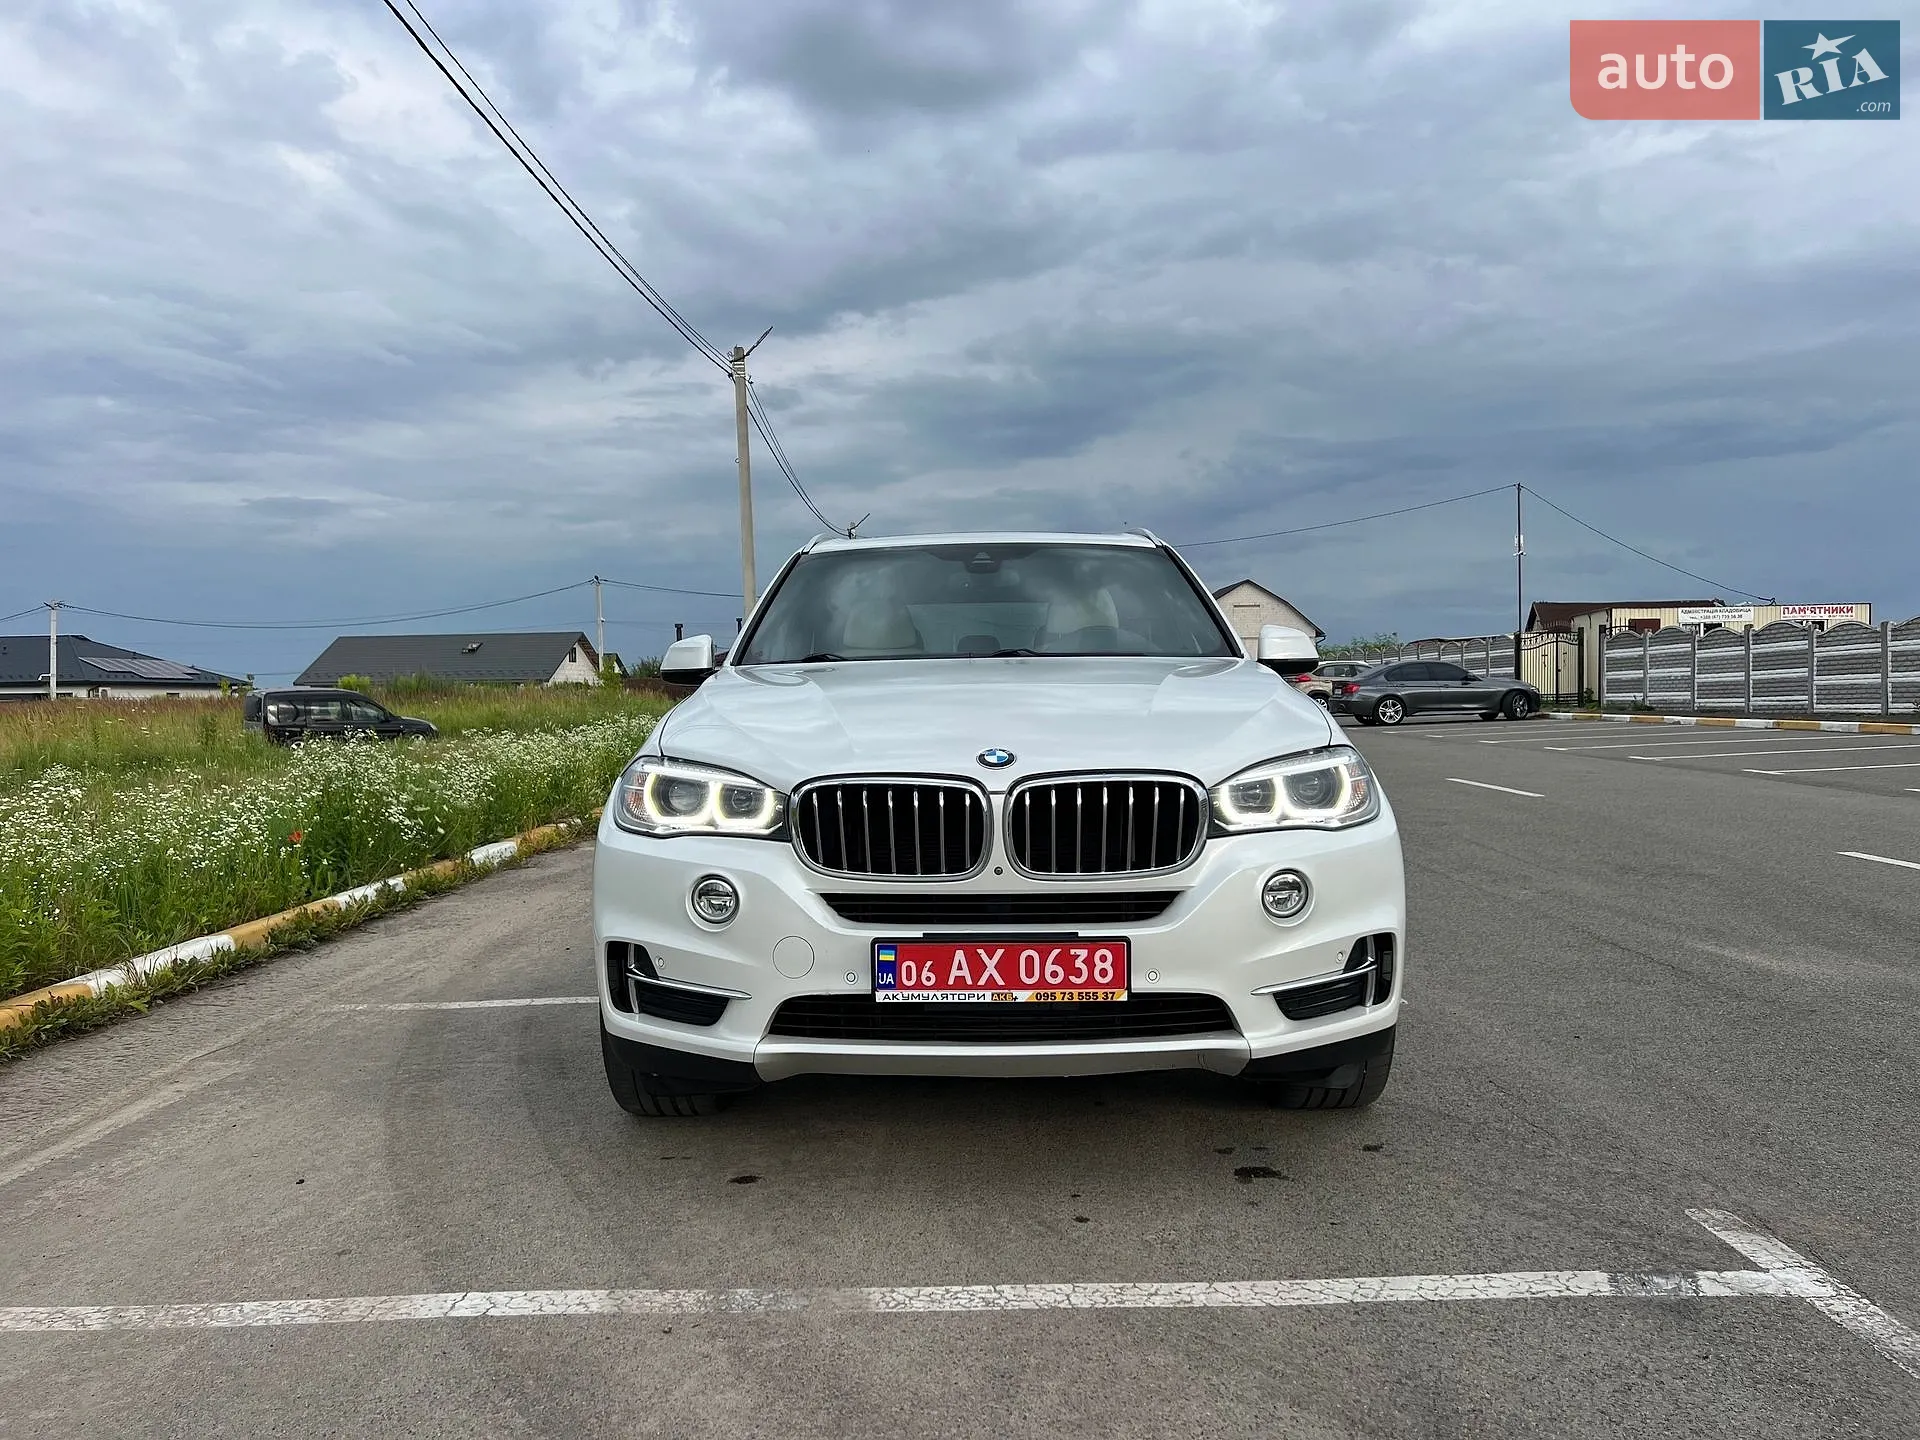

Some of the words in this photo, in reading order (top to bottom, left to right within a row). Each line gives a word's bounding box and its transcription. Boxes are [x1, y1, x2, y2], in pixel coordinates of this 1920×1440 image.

[901, 960, 937, 987] 06
[947, 948, 1006, 986] AX
[1019, 948, 1114, 985] 0638
[878, 973, 894, 985] UA
[882, 992, 986, 1001] АКУМУЛЯТОРИ
[1035, 991, 1057, 1001] 095
[1060, 991, 1074, 1001] 73
[1078, 991, 1099, 1001] 555
[1102, 991, 1116, 1001] 37
